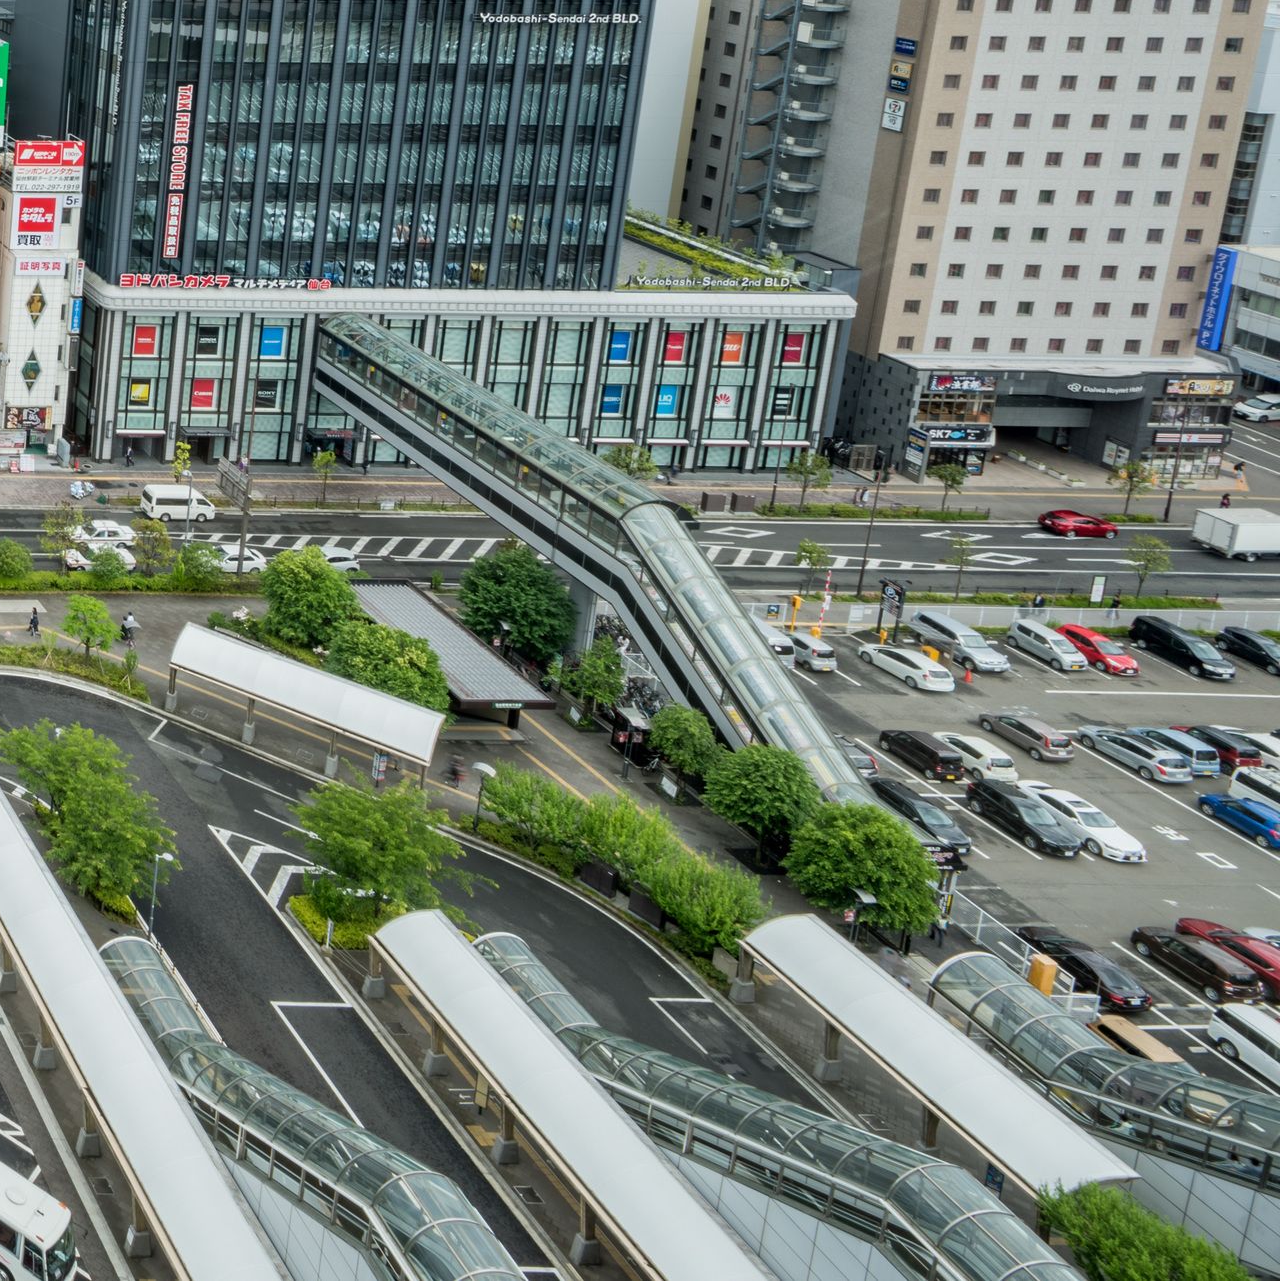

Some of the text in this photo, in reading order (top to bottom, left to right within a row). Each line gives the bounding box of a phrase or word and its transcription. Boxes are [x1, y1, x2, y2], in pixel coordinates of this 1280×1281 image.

[479, 12, 642, 24] Yodobashi-Sendai 2nd BLD.
[169, 84, 193, 190] TAX FREE STORE
[16, 167, 81, 175] ニッポンレンタカー
[65, 195, 79, 206] 5F
[17, 234, 42, 246] 買取
[19, 262, 61, 271] 証明写真
[120, 273, 331, 291] ヨドバシカメラ マルチメディア 仙台
[636, 275, 793, 287] Yodobashi-Sendai 2nd BLD.
[1082, 385, 1106, 394] Daiwa
[929, 429, 951, 438] SK7
